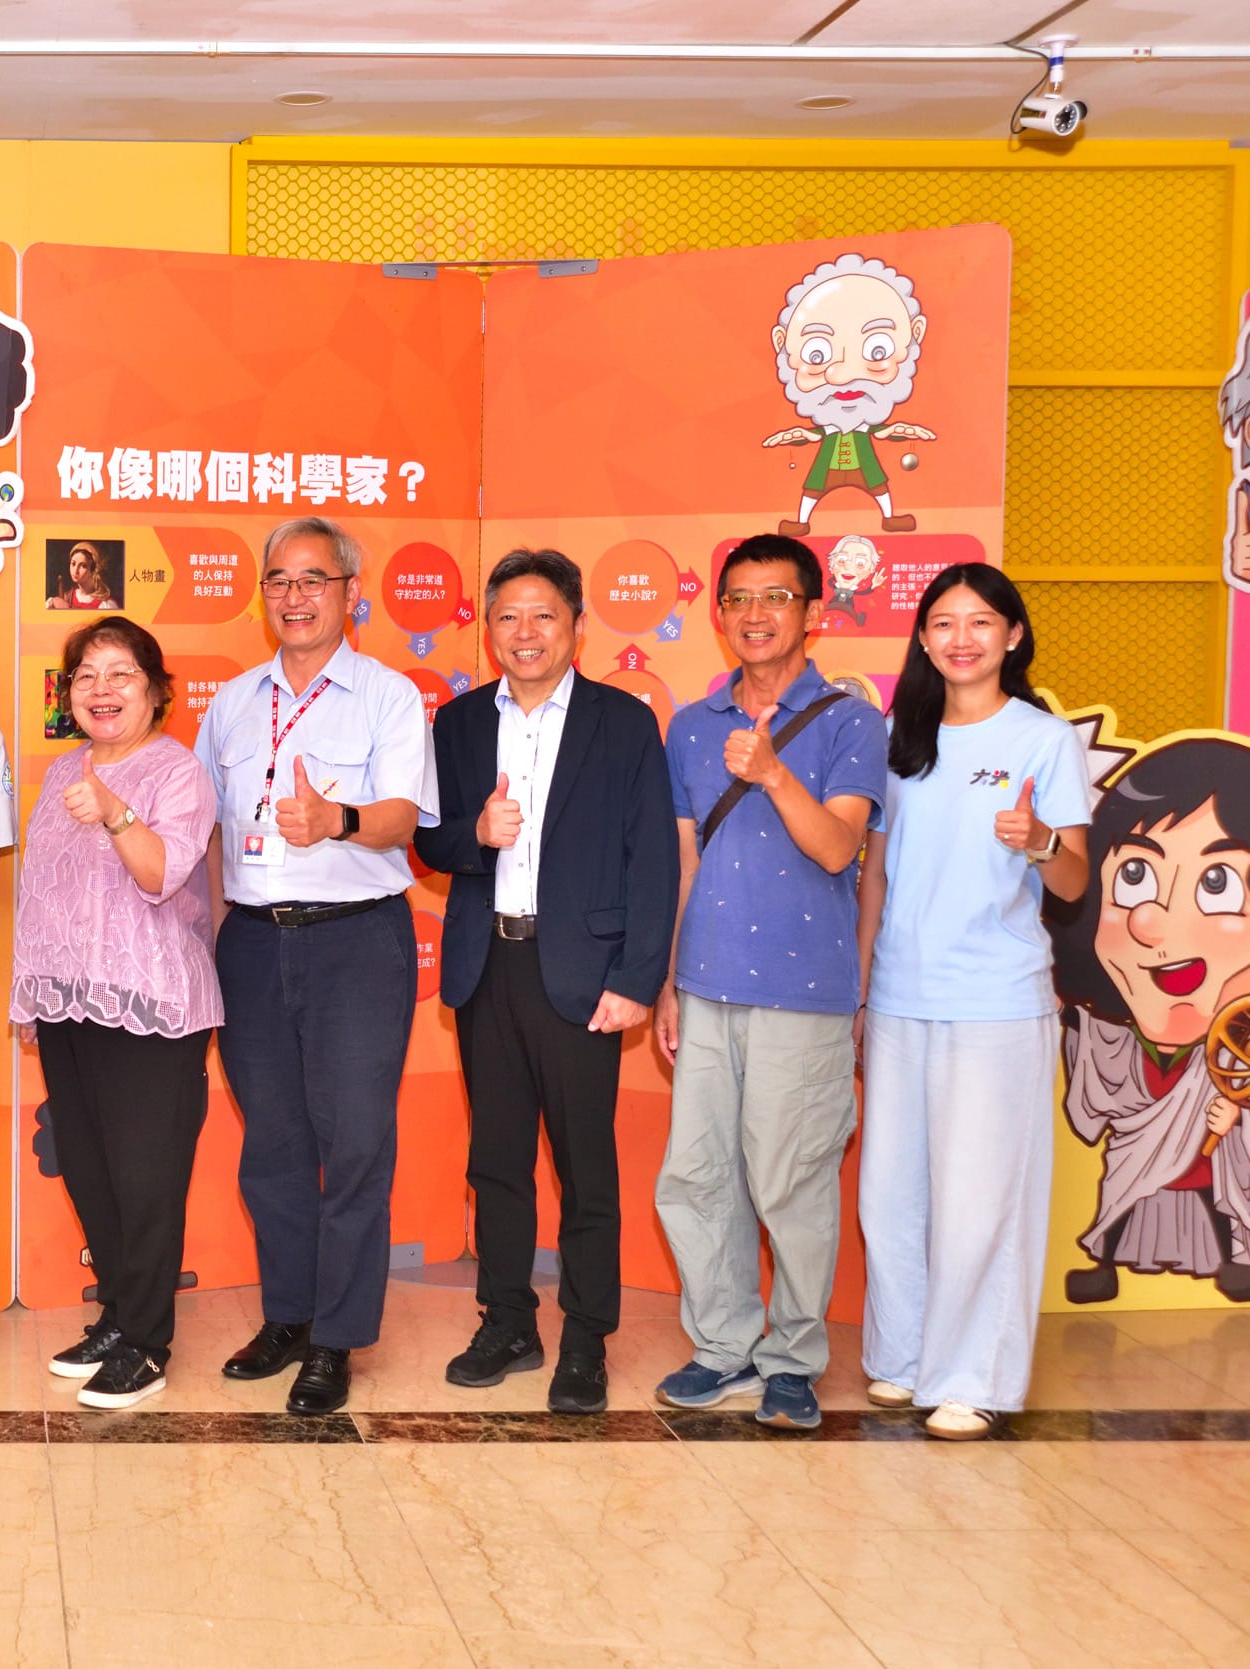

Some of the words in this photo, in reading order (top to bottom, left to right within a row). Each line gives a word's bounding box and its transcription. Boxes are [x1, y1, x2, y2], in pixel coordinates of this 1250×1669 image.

[129, 568, 166, 584] 人物畫
[193, 570, 234, 582] 的人保持
[617, 574, 649, 586] 你喜歡
[193, 585, 233, 597] 良好互動
[680, 582, 697, 592] NO
[352, 602, 368, 618] YES
[457, 607, 472, 620] NO
[662, 620, 679, 638] YES
[417, 637, 426, 655] YES
[628, 653, 637, 670] NO
[452, 678, 468, 692] YES
